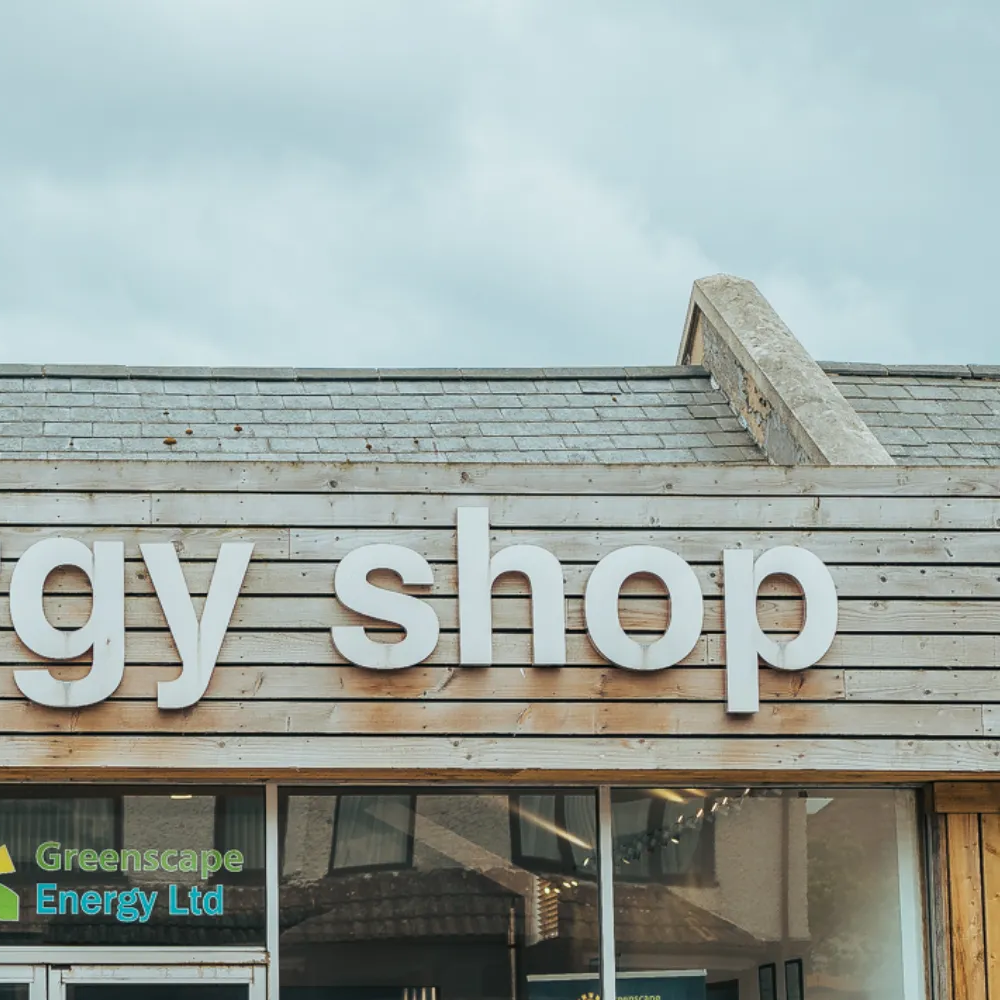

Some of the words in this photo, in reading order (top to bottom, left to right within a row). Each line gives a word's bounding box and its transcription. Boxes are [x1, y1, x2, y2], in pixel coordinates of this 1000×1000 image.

[329, 505, 838, 714] shop
[35, 841, 245, 879] Greenscape
[36, 883, 158, 923] Energy
[168, 884, 224, 916] Ltd
